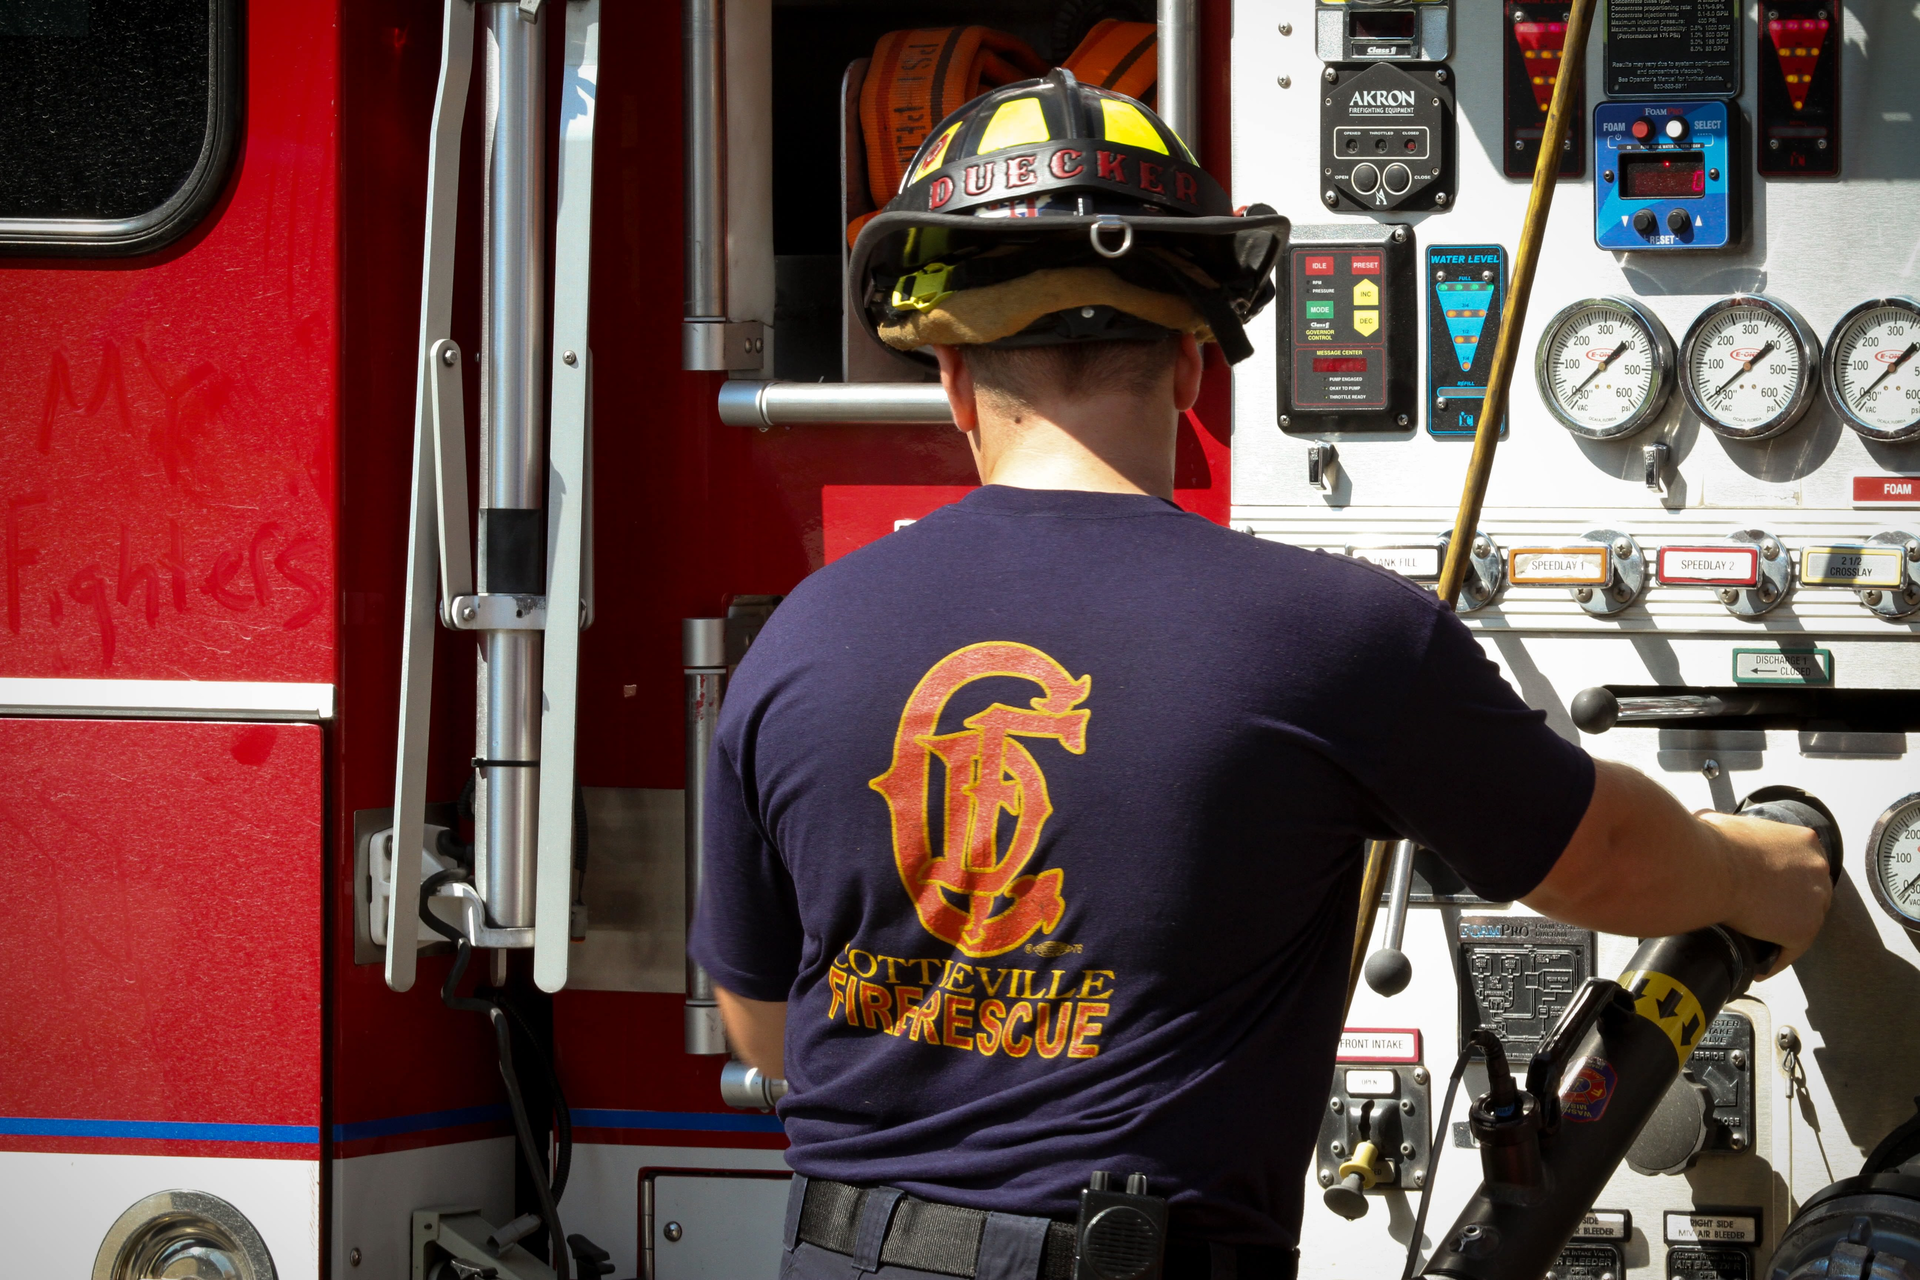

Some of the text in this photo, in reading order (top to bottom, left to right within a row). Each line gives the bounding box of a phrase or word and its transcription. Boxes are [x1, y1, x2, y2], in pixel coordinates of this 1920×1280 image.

[1349, 90, 1415, 106] AKRON
[1603, 120, 1722, 132] FOAM SELECT
[929, 149, 1199, 211] DUECKER
[1650, 235, 1675, 244] RESET
[1431, 255, 1499, 264] WATER LEVEL
[1598, 325, 1614, 334] 300
[1742, 324, 1758, 334] 300
[1887, 326, 1904, 336] 300
[1573, 336, 1590, 346] 200
[1620, 340, 1636, 350] 00
[1717, 336, 1734, 346] 200
[1862, 337, 1879, 347] 200
[1564, 359, 1580, 369] 100
[1708, 359, 1724, 369] 100
[1853, 360, 1868, 370] 100
[1624, 365, 1640, 375] 500
[1770, 365, 1787, 374] 500
[1616, 388, 1632, 398] 600
[1761, 388, 1778, 398] 600
[1621, 404, 1630, 413] psi
[1767, 404, 1776, 413] psi
[1884, 483, 1912, 495] FOAM
[1400, 558, 1417, 567] FILL
[1532, 560, 1584, 571] SPEEDLAY 1
[1681, 560, 1735, 571] SPEEDLAY 2
[1842, 556, 1862, 566] 2 1/2
[1830, 567, 1872, 577] CROSSLAY
[1756, 655, 1807, 665] DISCHARGE 1
[1780, 667, 1811, 676] CLOSED
[1896, 853, 1911, 863] 100
[909, 990, 1110, 1059] RESCUE
[1340, 1039, 1403, 1049] FRONT INTAKE
[1694, 1051, 1725, 1060] ERRIDE
[1582, 1216, 1598, 1225] SIDE
[1691, 1218, 1734, 1228] RIGHT SIDE
[1583, 1227, 1614, 1236] BLEEDER
[1698, 1230, 1711, 1238] AIR
[1714, 1231, 1745, 1240] BLEEDER
[1566, 1257, 1612, 1266] BLEEDER
[1570, 1267, 1589, 1276] OPEN
